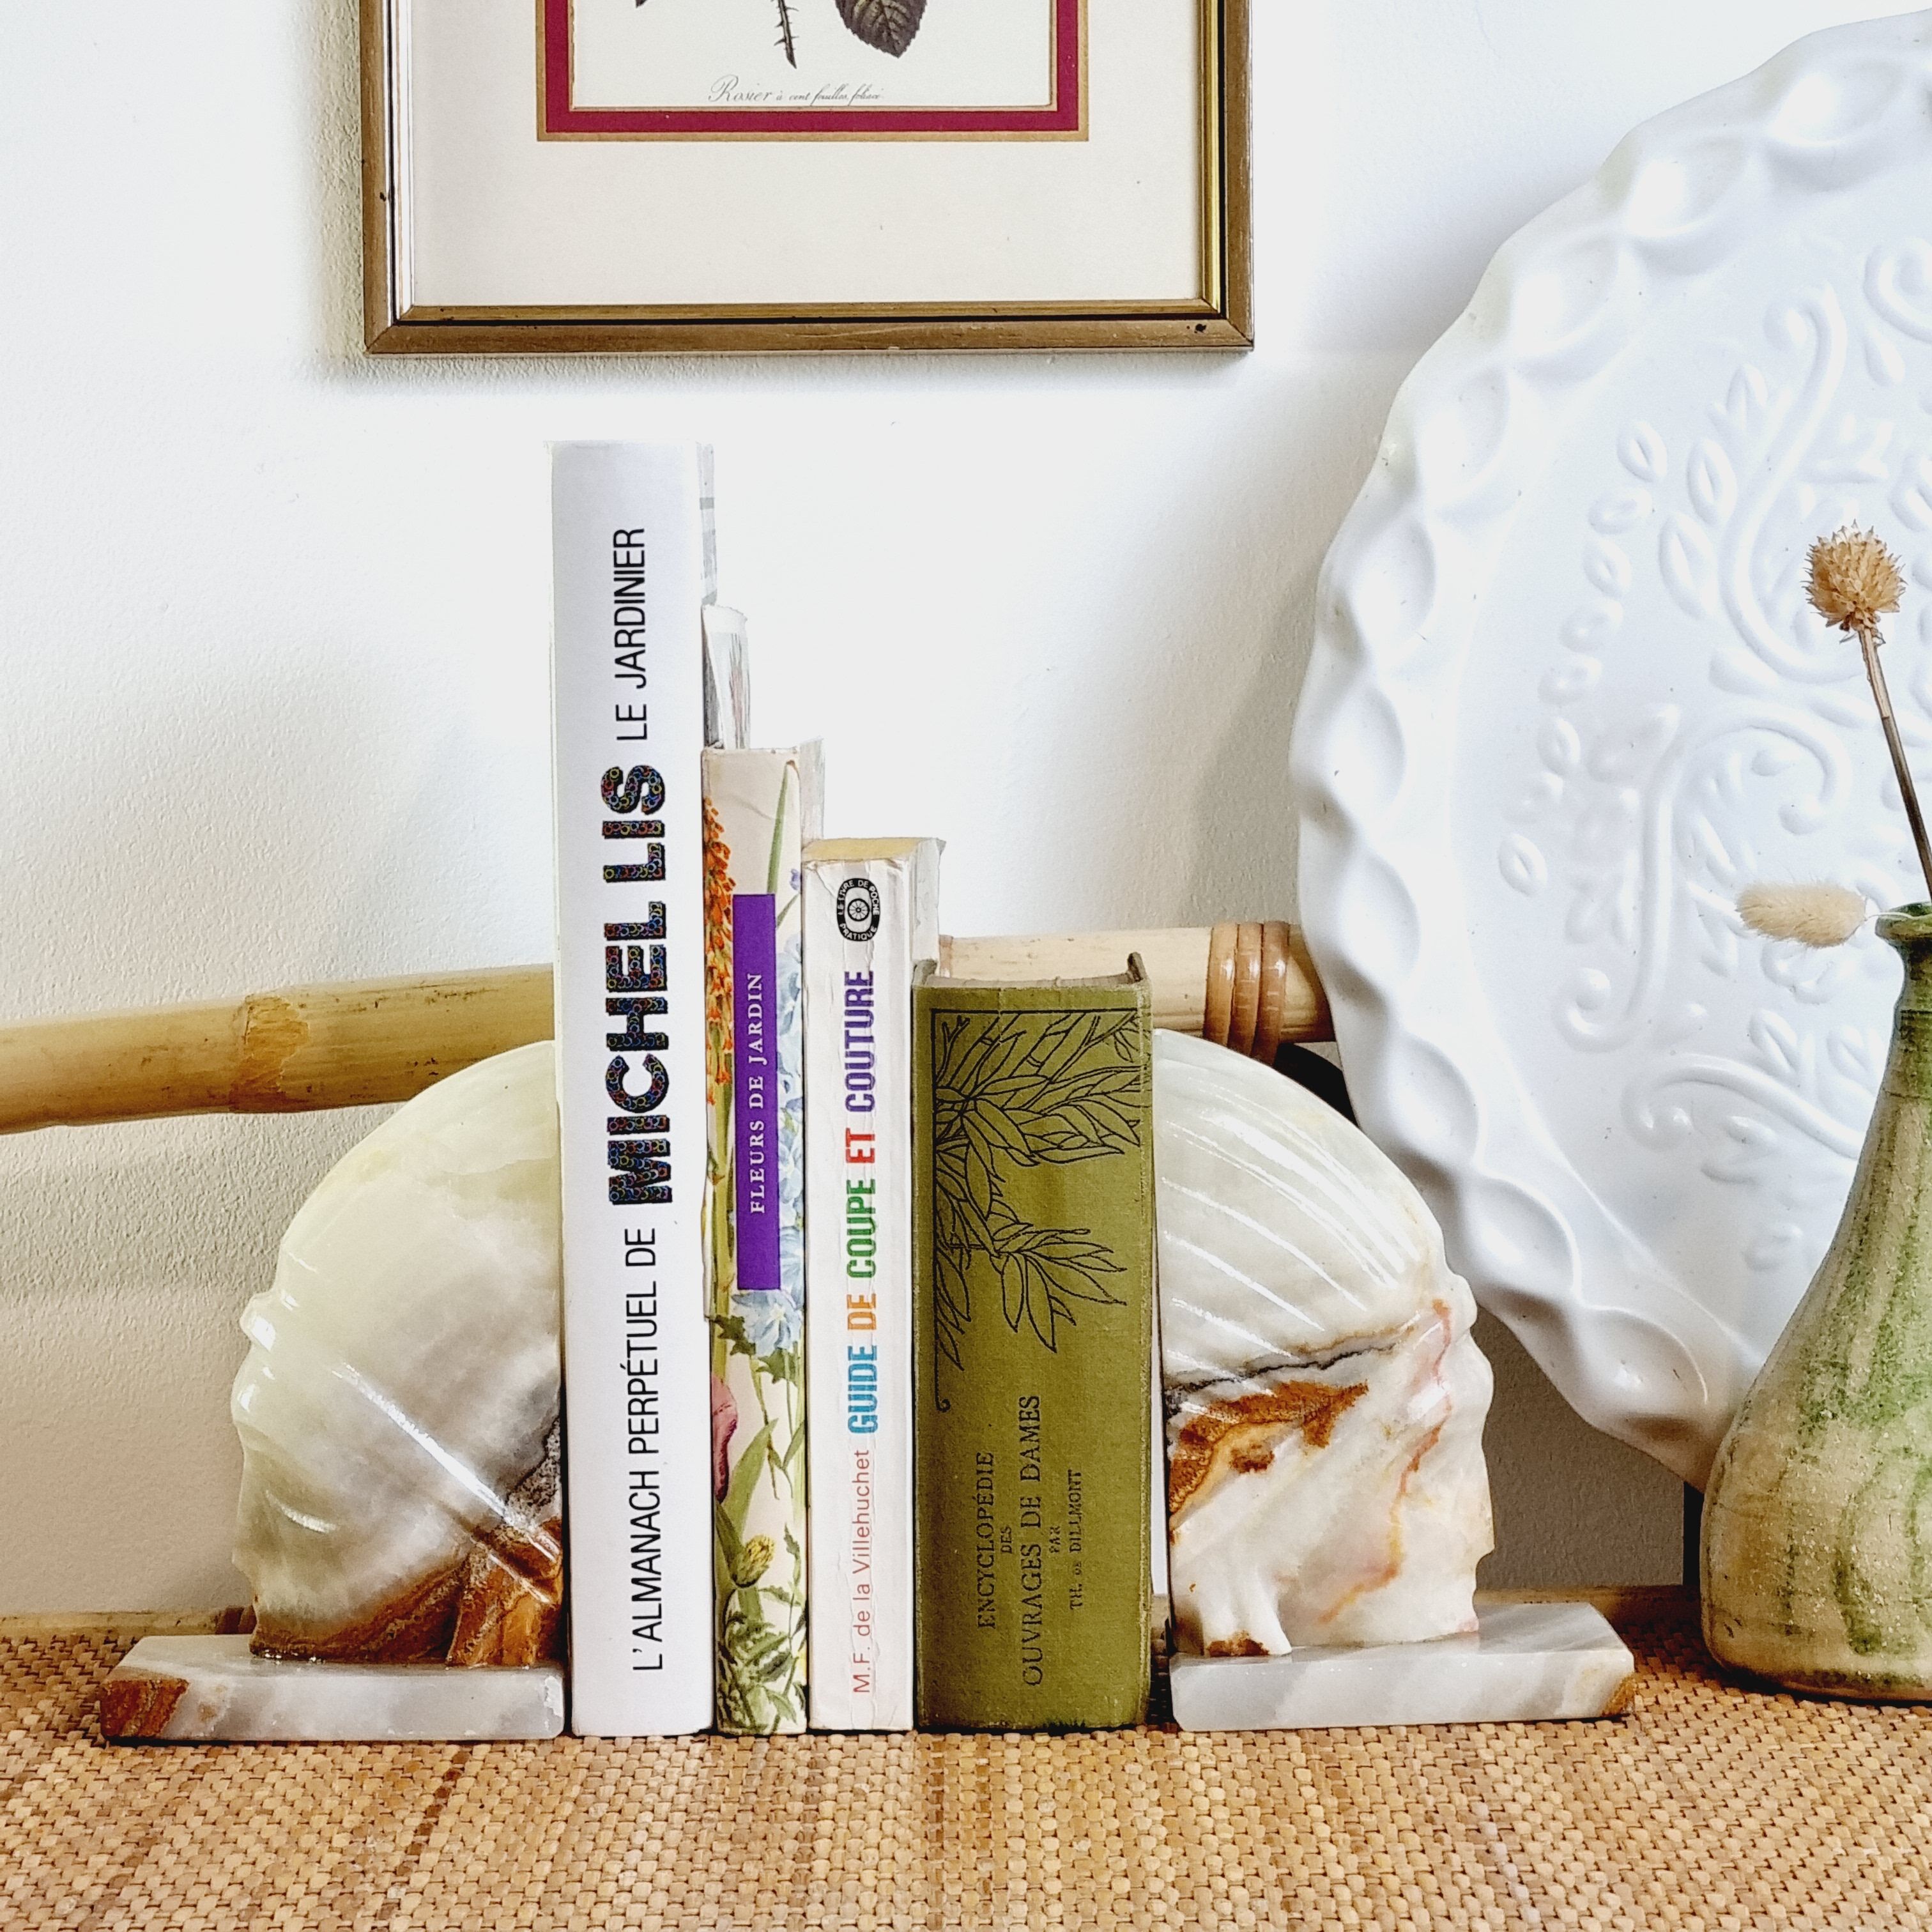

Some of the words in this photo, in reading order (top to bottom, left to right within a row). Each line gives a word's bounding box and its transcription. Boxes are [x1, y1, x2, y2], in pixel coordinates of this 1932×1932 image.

[709, 75, 772, 102] Rosier
[788, 92, 810, 101] cent
[613, 528, 647, 689] JARDINIER
[615, 704, 647, 740] LE
[601, 765, 666, 884] LIS
[839, 923, 877, 940] PRATIQUE
[857, 880, 869, 888] DE
[870, 885, 880, 915] POCHE
[604, 901, 673, 1206] MICHEL
[747, 974, 767, 1065] JARDIN
[845, 970, 875, 1112] COUTURE
[749, 1076, 764, 1108] DE
[749, 1120, 765, 1213] FLEURS
[845, 1128, 875, 1163] ET
[624, 1228, 656, 1267] DE
[847, 1179, 876, 1279] COUPE
[847, 1294, 876, 1330] DE
[620, 1281, 659, 1454] PERPÉTUEL
[847, 1345, 878, 1433] GUIDE
[1018, 1395, 1041, 1483] DAMES
[852, 1450, 870, 1574] Villehuchet
[972, 1452, 997, 1629] ENCYCLOPÉDIE
[1000, 1525, 1013, 1555] DES
[1020, 1496, 1042, 1529] DE
[1048, 1525, 1062, 1554] PAR
[1067, 1469, 1083, 1554] DILLMONT
[629, 1471, 663, 1670] L'ALMANACH
[852, 1583, 870, 1600] la
[852, 1611, 870, 1636] de
[1020, 1544, 1043, 1687] OUVRAGES
[852, 1646, 870, 1693] M.F.
